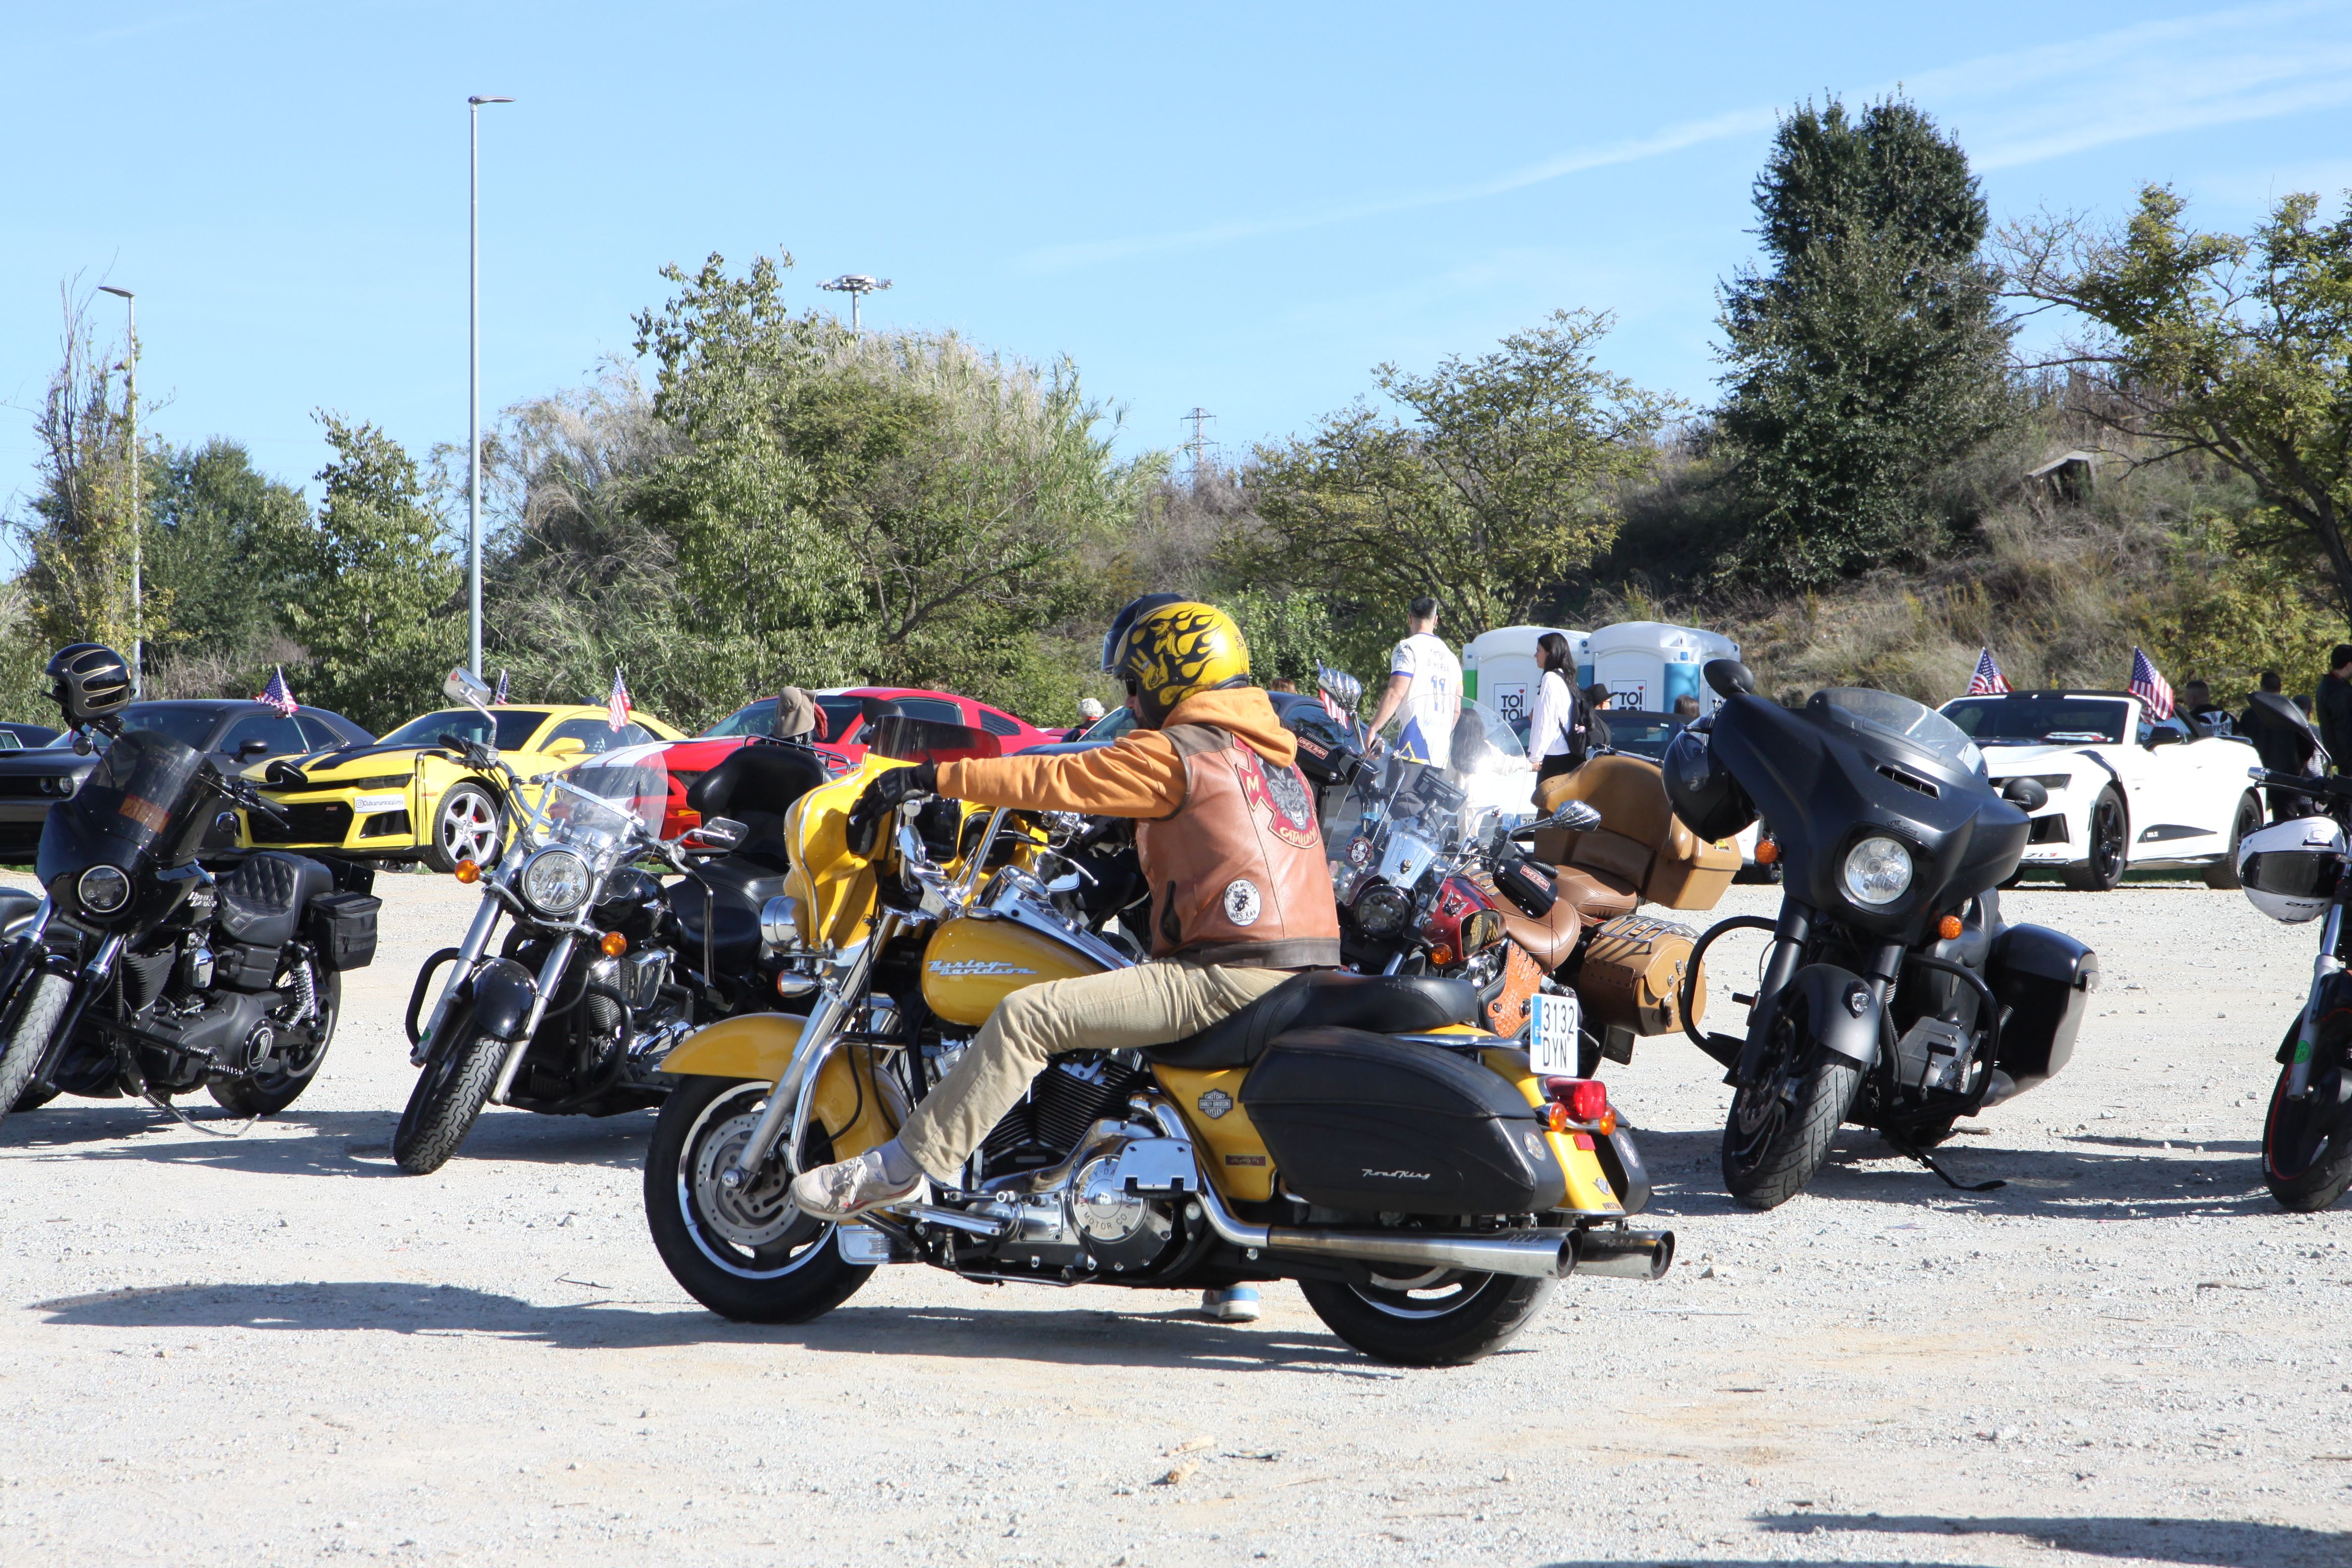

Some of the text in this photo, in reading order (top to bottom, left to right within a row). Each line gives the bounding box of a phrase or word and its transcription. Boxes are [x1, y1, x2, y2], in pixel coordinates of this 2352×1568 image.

[1501, 694, 1523, 708] TOI
[1619, 692, 1642, 705] TOI
[1246, 775, 1259, 793] M
[927, 959, 1013, 972] Harley
[939, 967, 1038, 976] Davidson
[1543, 1002, 1574, 1035] 3132
[1535, 1026, 1539, 1037] E
[1543, 1036, 1567, 1069] DYN
[1083, 1212, 1113, 1229] MOTOR
